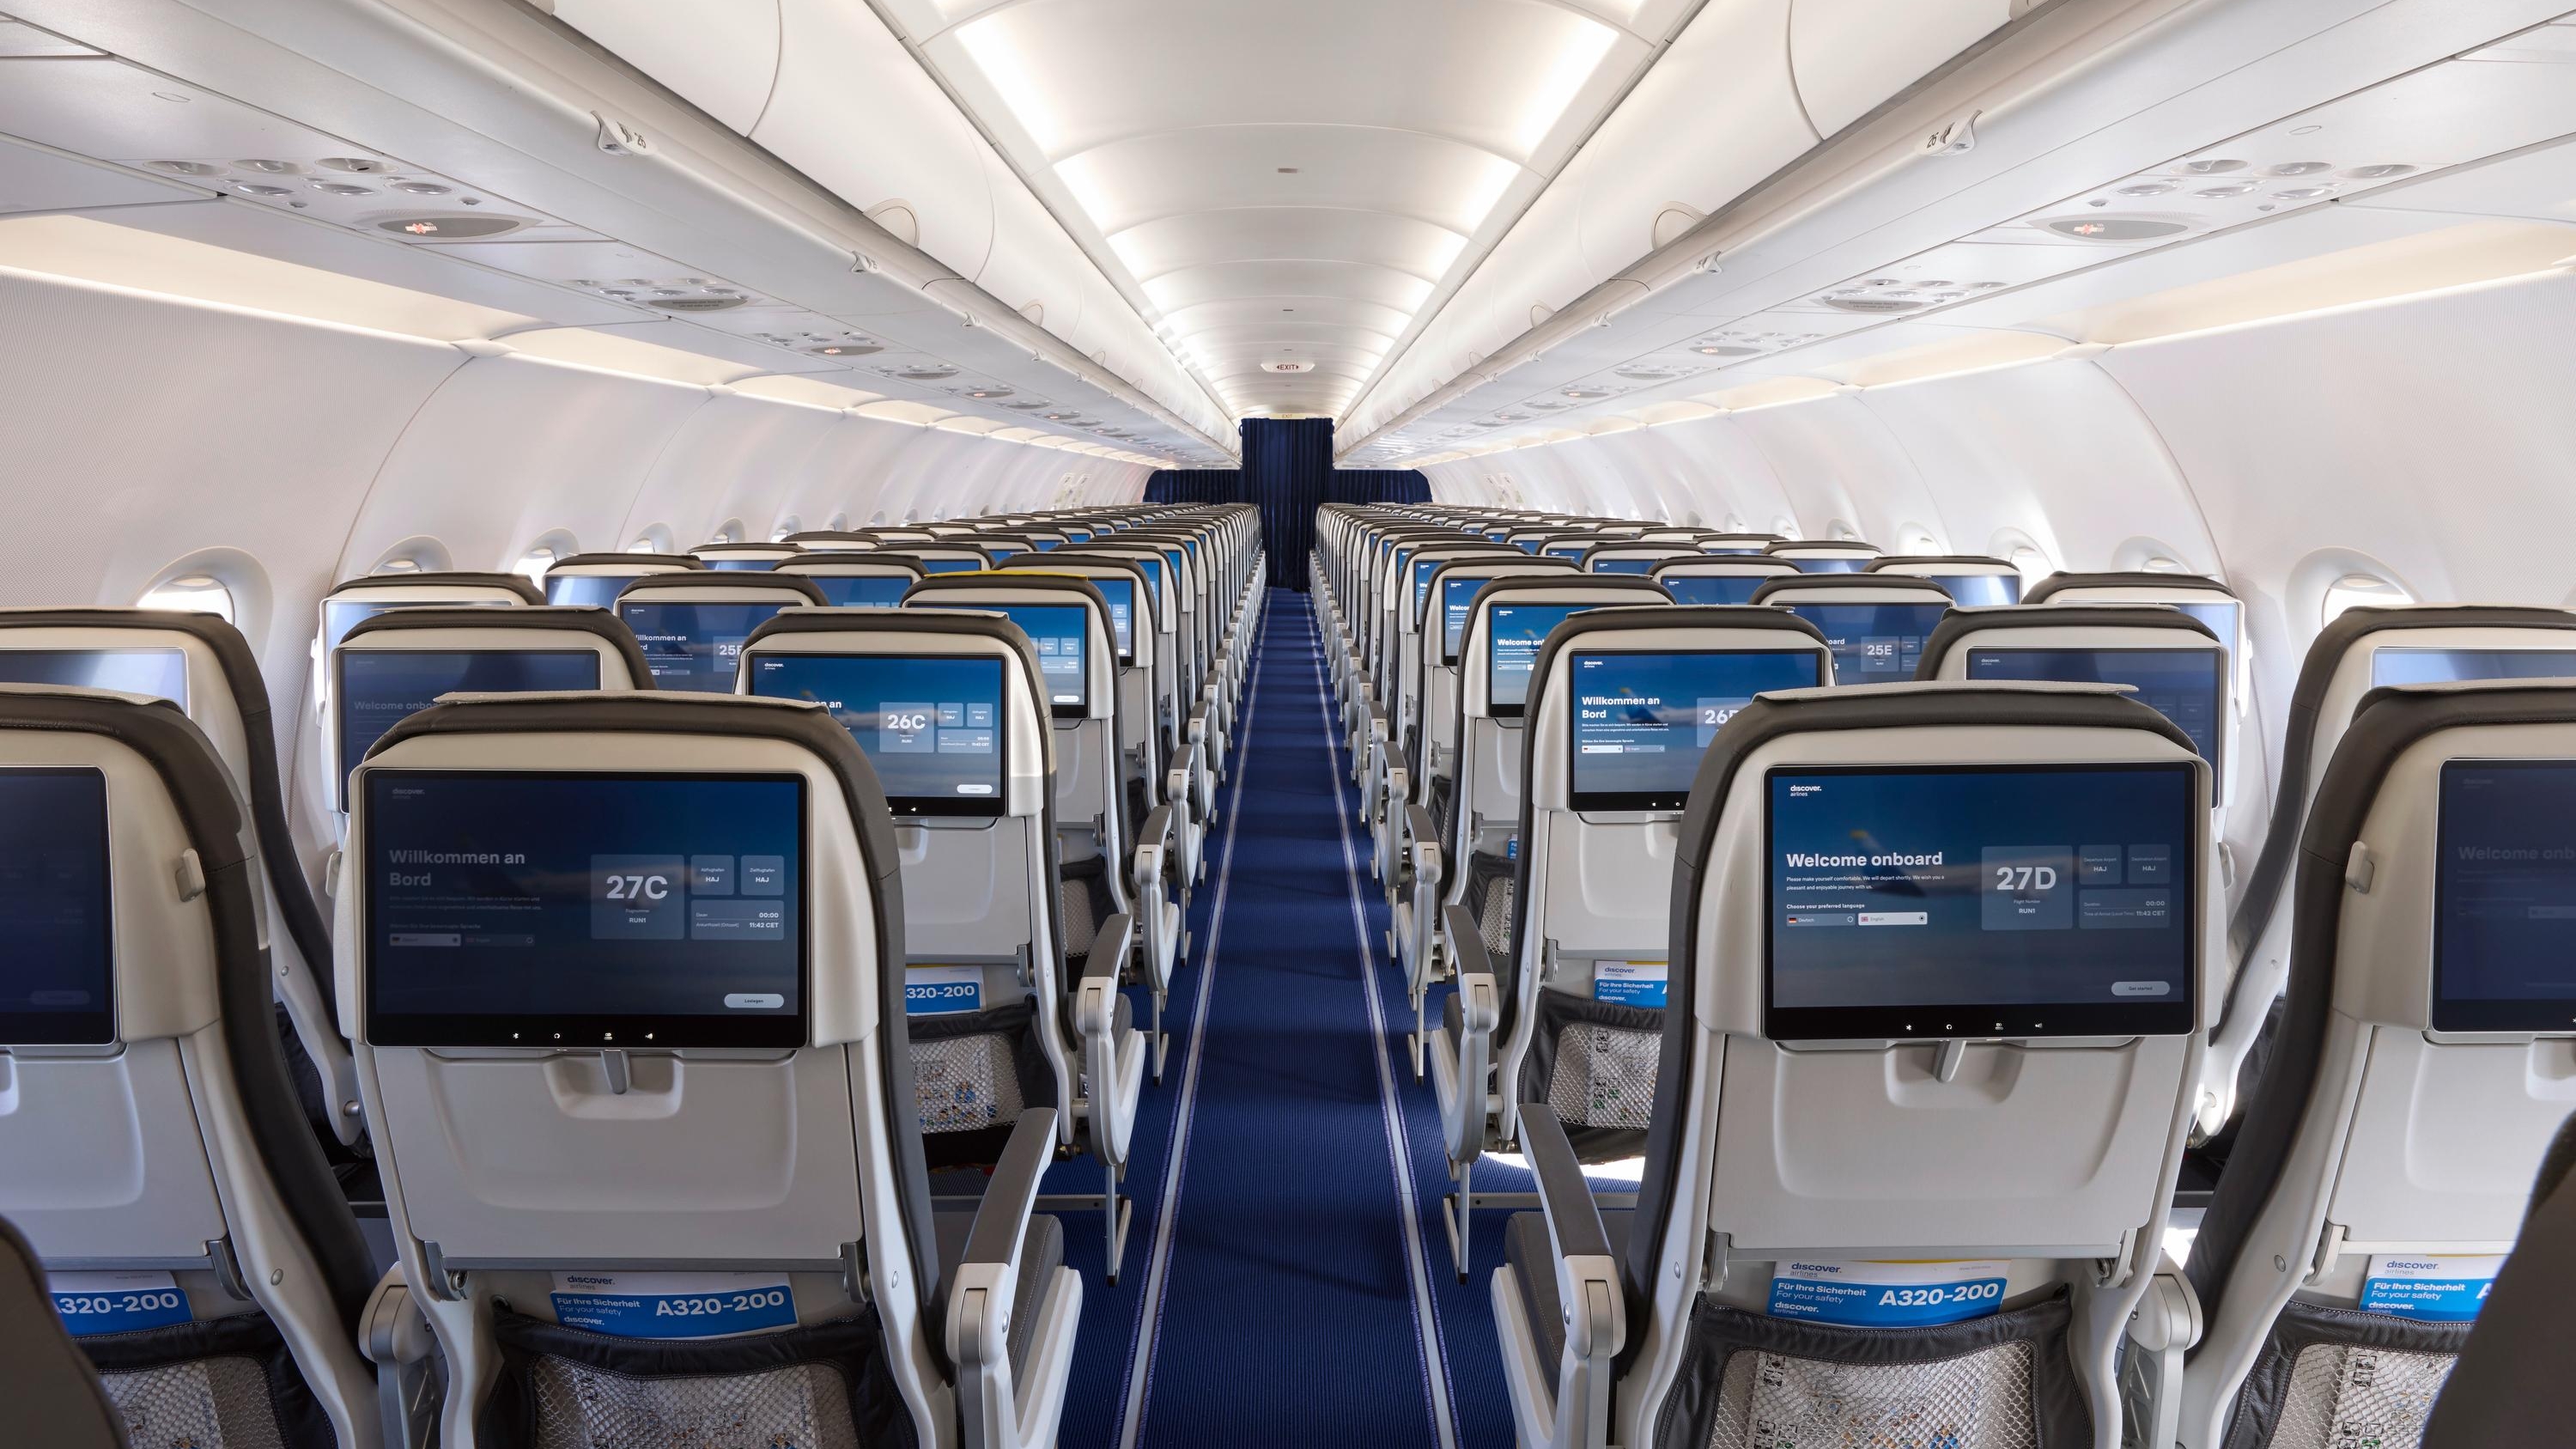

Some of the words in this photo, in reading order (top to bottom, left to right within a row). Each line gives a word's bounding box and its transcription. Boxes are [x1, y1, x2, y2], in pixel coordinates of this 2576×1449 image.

[1927, 131, 1939, 149] 26
[1867, 644, 1893, 655] 25E
[354, 700, 404, 710] Welcome
[1582, 697, 1645, 705] Willkommen
[1582, 709, 1607, 719] Bord
[887, 714, 926, 729] 26C
[389, 849, 500, 864] Willkommen
[504, 853, 526, 865] an
[2458, 845, 2538, 861] Welcome
[1786, 853, 1867, 868] Welcome
[1871, 852, 1943, 867] onboard
[390, 872, 432, 886] Bord
[1996, 867, 2057, 891] 27D
[606, 874, 668, 899] 27C
[905, 985, 975, 999] 320-200
[1791, 1263, 1842, 1274] discover.
[2386, 1260, 2439, 1270] discover.
[568, 1275, 616, 1286] discover.
[2393, 1282, 2412, 1291] Ihre
[2414, 1283, 2465, 1292] Sicherheit
[1778, 1282, 1795, 1291] Für
[1795, 1283, 1815, 1293] Ihre
[1816, 1285, 1867, 1297] Sicherheit
[1878, 1282, 2000, 1306] A320-200
[556, 1297, 572, 1306] Für
[593, 1299, 641, 1308] Sicherheit
[1794, 1292, 1814, 1301] your
[1815, 1294, 1844, 1305] safety
[2412, 1292, 2442, 1301] safety
[54, 1293, 179, 1314] 320-200
[655, 1291, 785, 1317] A320-200
[1775, 1302, 1820, 1313] discover.
[2368, 1301, 2415, 1311] discover.
[560, 1305, 574, 1313] For
[576, 1306, 594, 1315] your
[596, 1307, 622, 1318] safety
[563, 1316, 605, 1326] discover.
